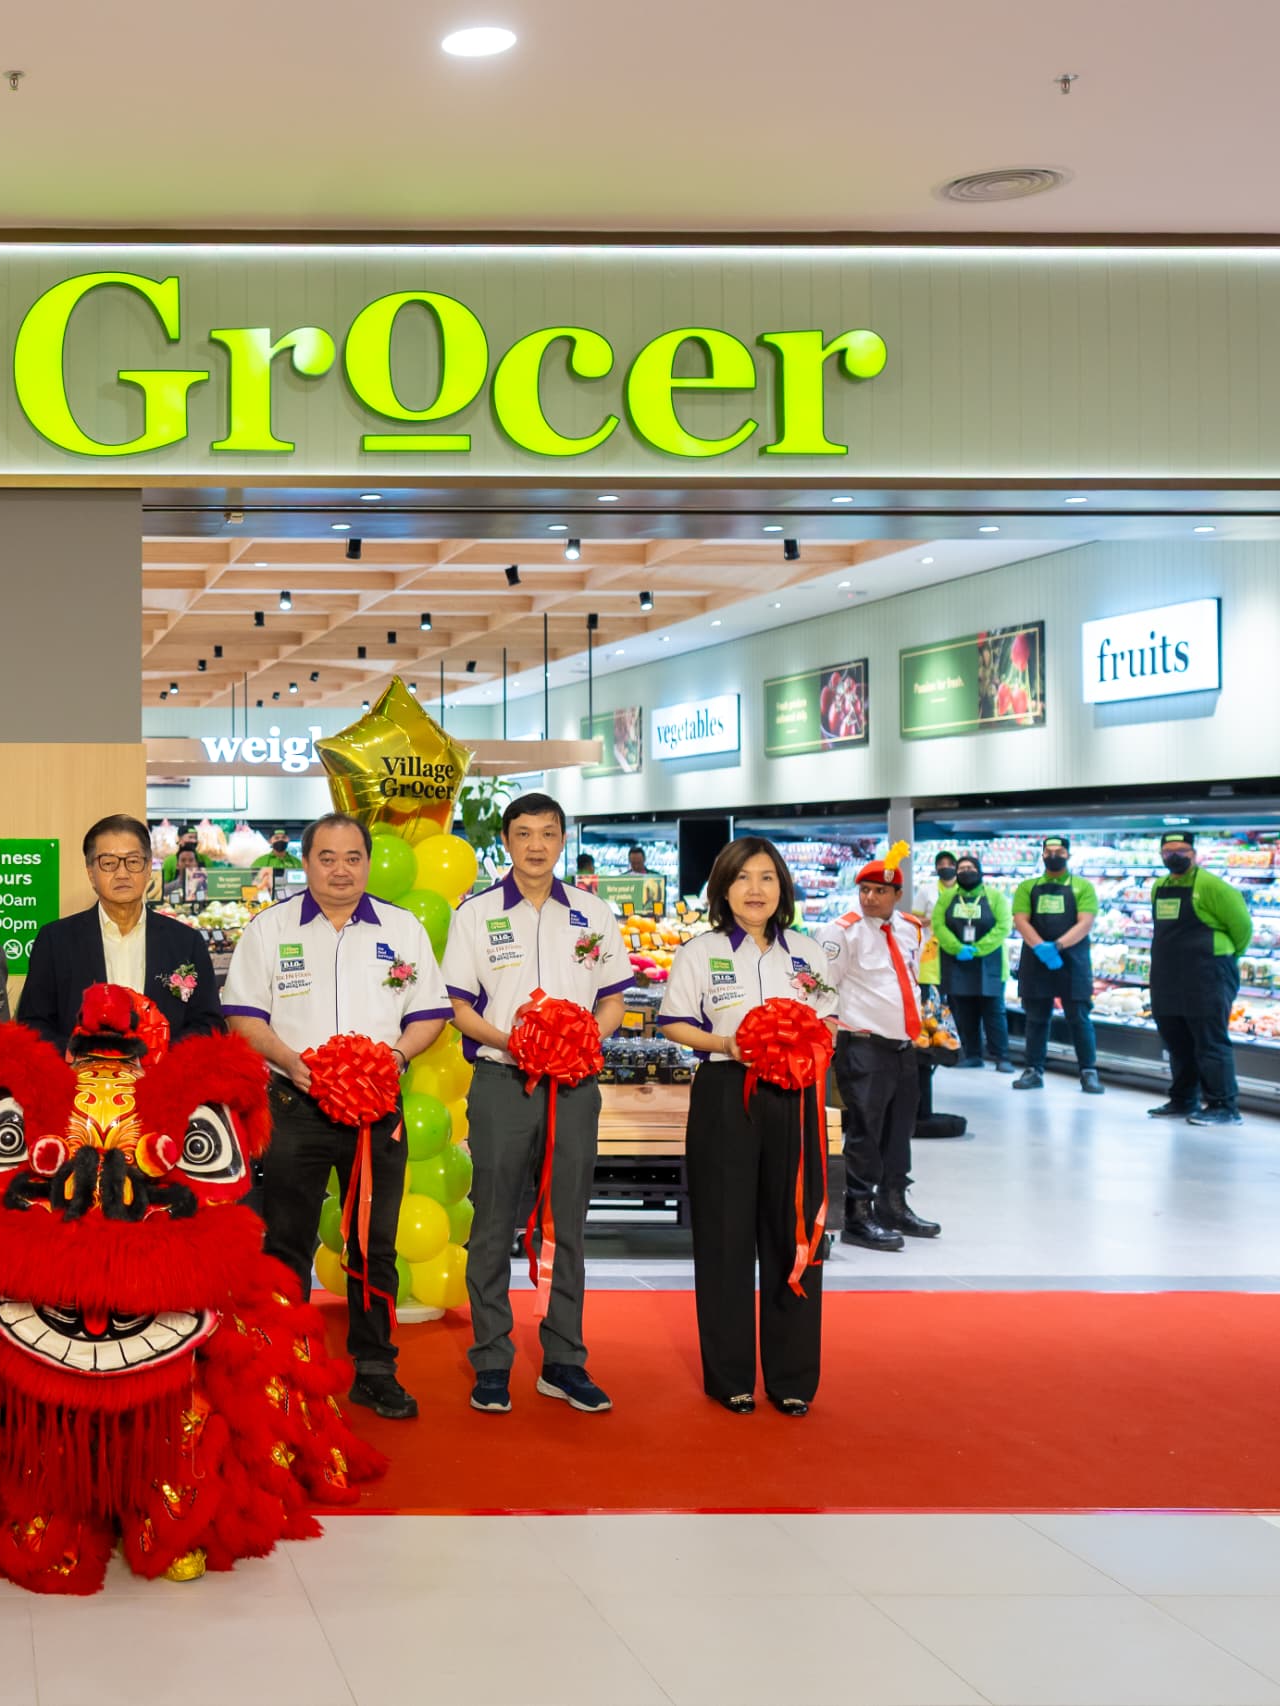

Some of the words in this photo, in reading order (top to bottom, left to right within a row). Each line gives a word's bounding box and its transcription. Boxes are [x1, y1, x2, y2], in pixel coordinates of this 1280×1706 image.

[14, 271, 888, 457] Grocer
[1096, 630, 1190, 683] fruits
[657, 708, 724, 750] vegetables
[380, 777, 455, 799] Grocer
[381, 756, 455, 784] Village
